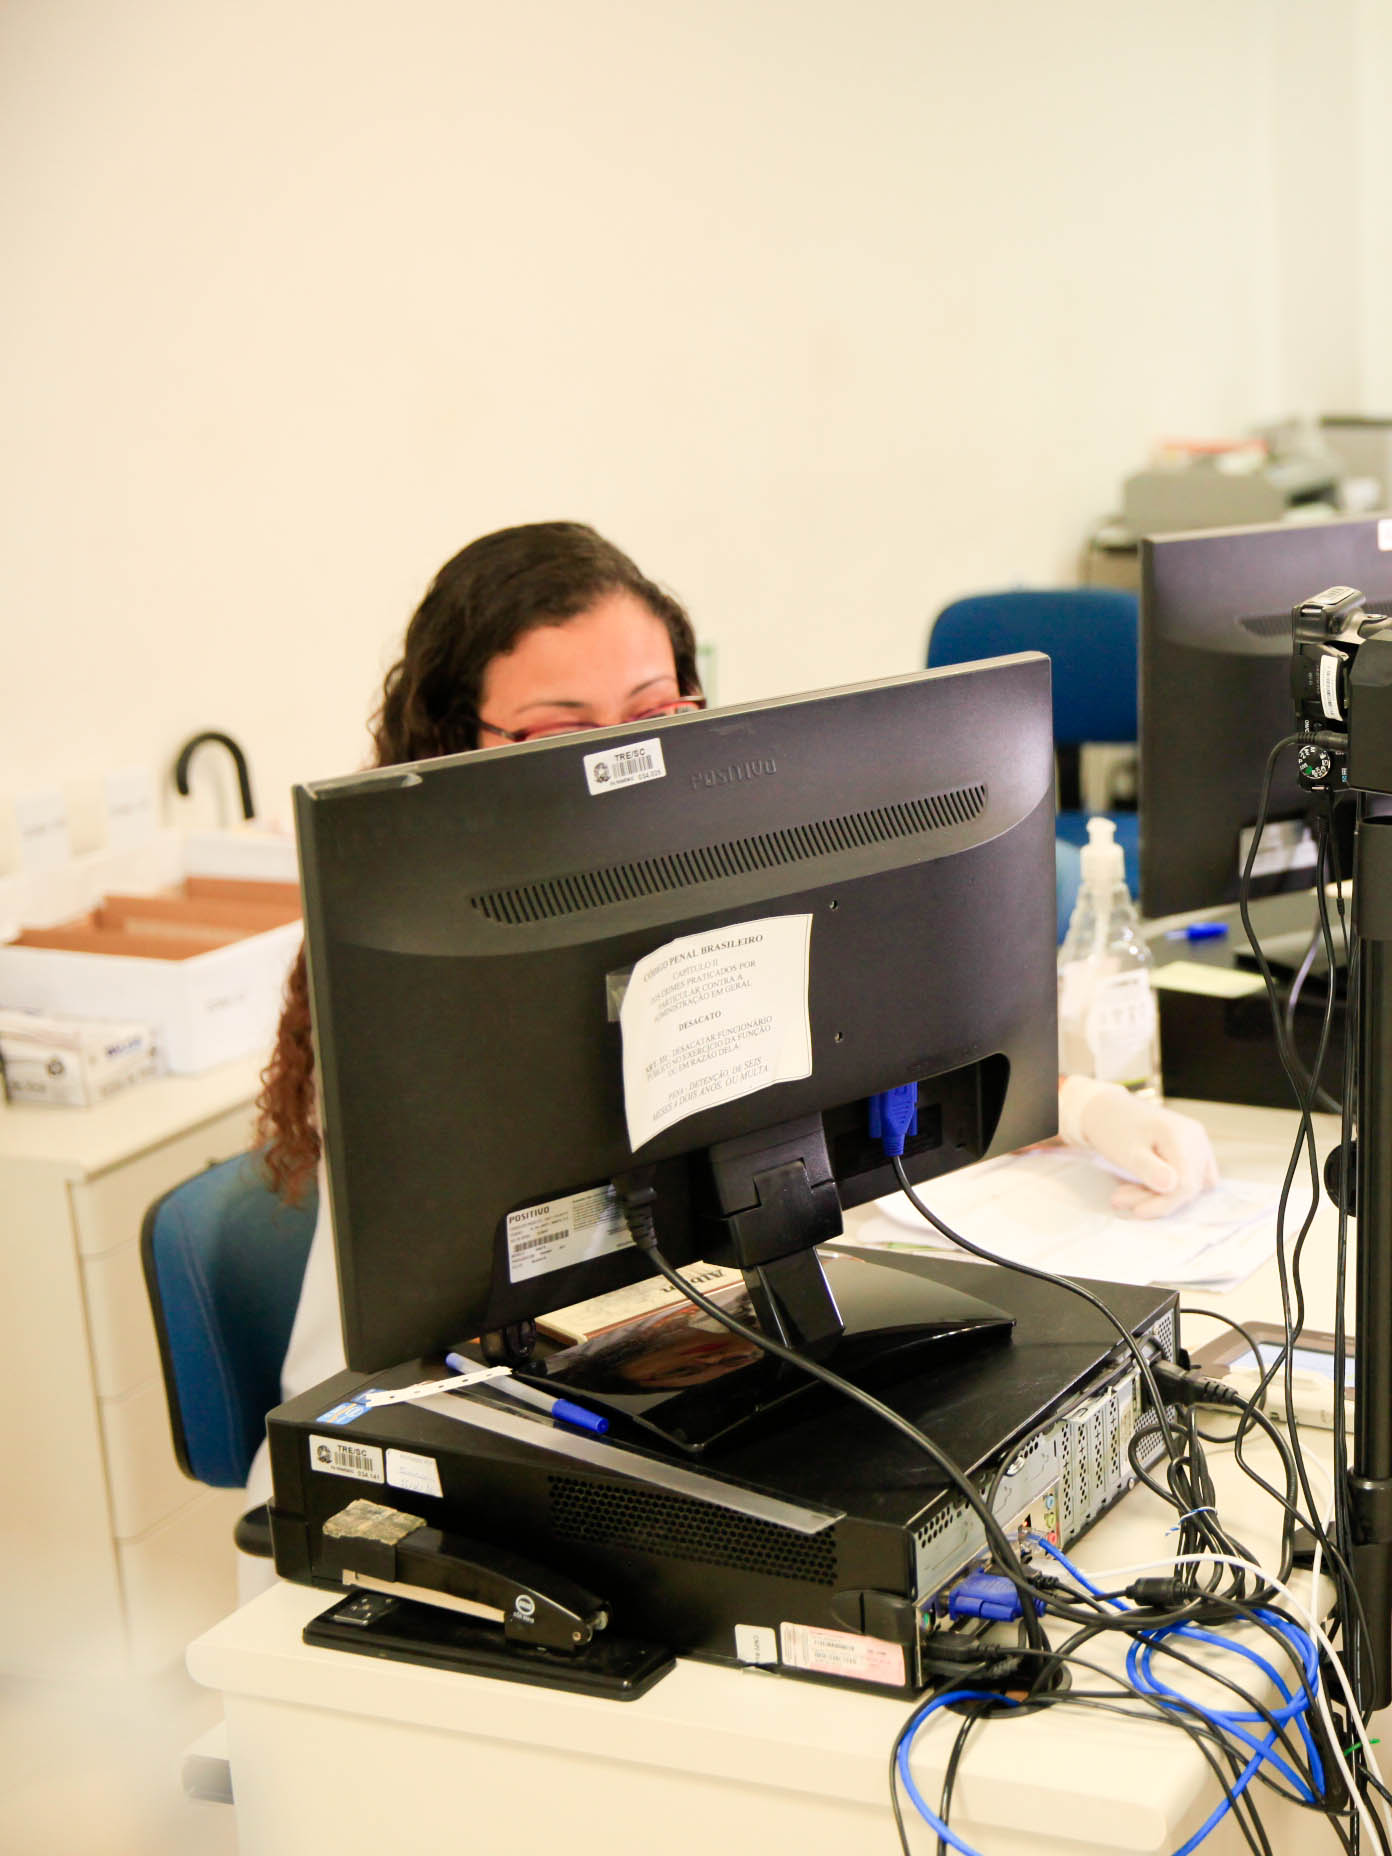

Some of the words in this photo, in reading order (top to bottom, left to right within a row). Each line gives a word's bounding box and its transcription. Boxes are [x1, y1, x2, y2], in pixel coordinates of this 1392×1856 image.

[614, 747, 646, 761] TRE/SC
[689, 758, 777, 790] POSITIVO
[668, 948, 699, 967] PENAL
[701, 934, 764, 955] BRASILEIRO
[687, 964, 737, 985] PRATICADOS
[739, 959, 757, 971] POR
[702, 975, 735, 992] CONTRA
[711, 987, 724, 998] EM
[724, 979, 752, 993] GERAL
[679, 1010, 722, 1032] DESACATO
[672, 1033, 715, 1056] DESACATAR
[724, 1036, 737, 1046] DA
[744, 1056, 762, 1071] SEIS
[679, 1088, 698, 1105] DOIS
[725, 1074, 739, 1088] OU
[740, 1065, 769, 1081] MULTA
[508, 1205, 551, 1225] POSITIVO
[337, 1444, 368, 1457] TRE/SC
